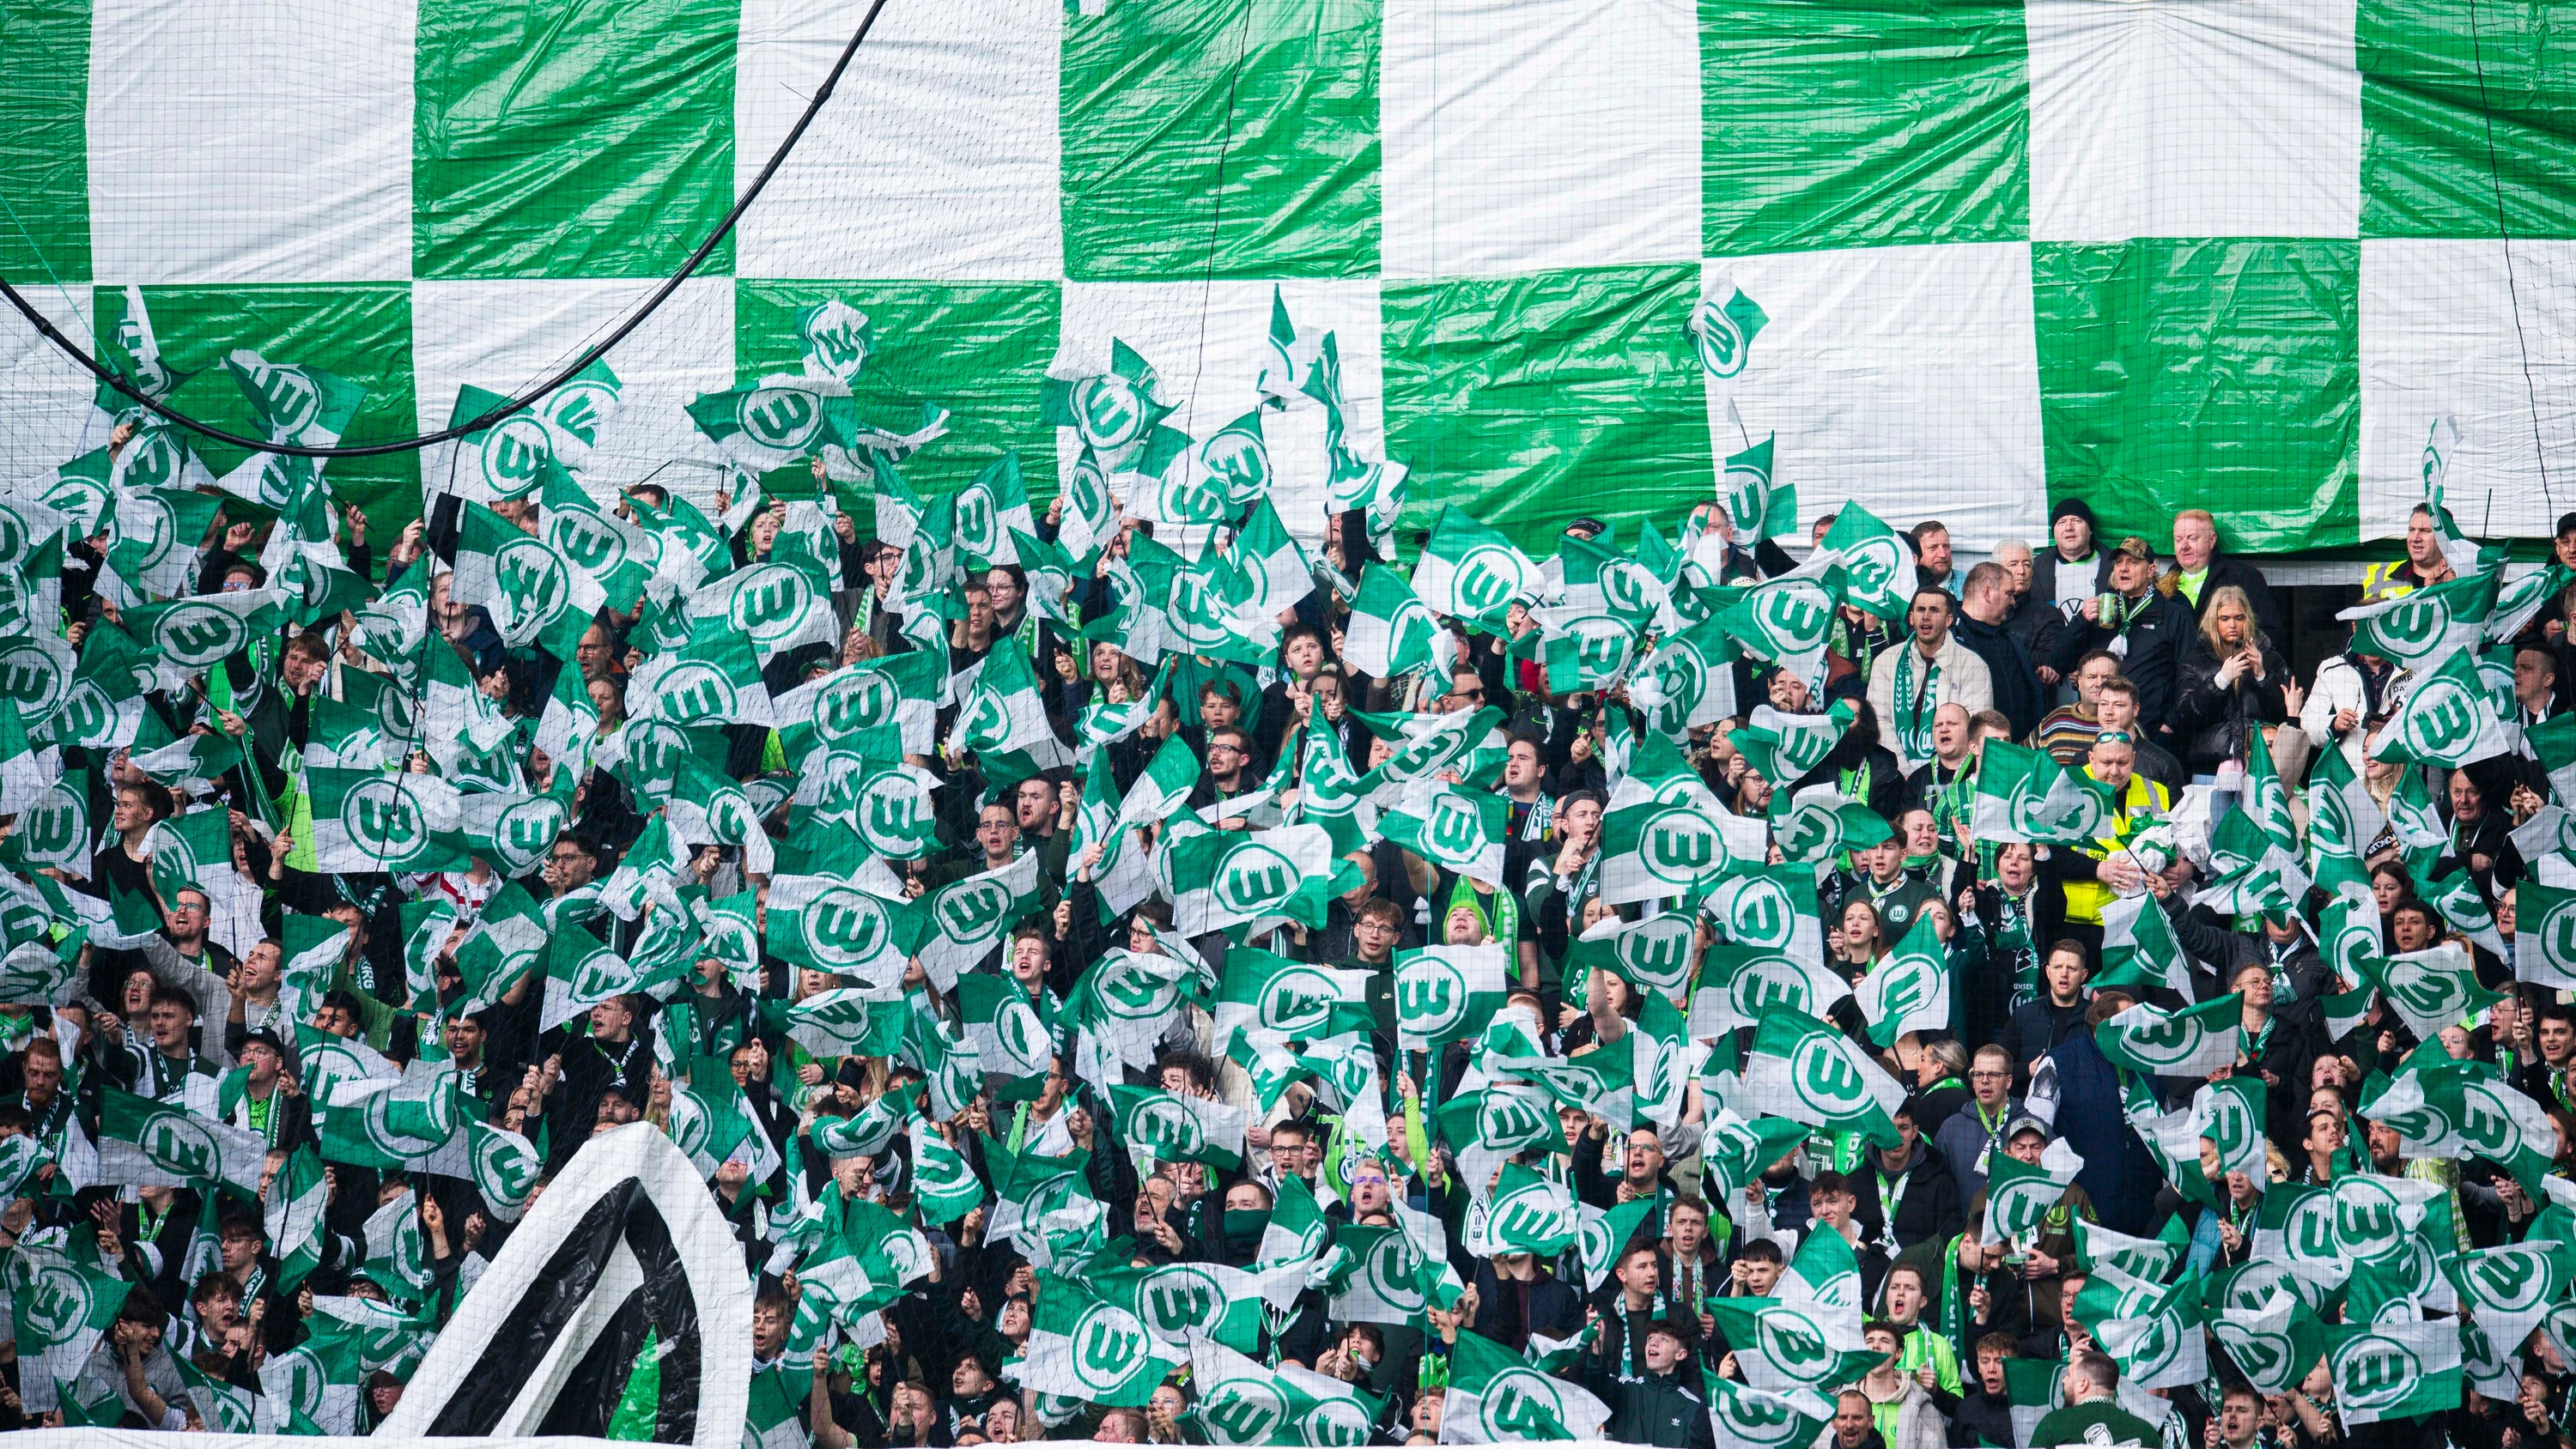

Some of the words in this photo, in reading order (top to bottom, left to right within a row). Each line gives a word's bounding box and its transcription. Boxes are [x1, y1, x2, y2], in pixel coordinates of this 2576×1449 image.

[814, 322, 859, 364] W
[749, 392, 811, 440] W
[496, 433, 548, 481] W
[559, 516, 615, 569] W
[744, 579, 797, 627] W
[1462, 561, 1515, 615] W
[166, 615, 232, 656] W
[1769, 591, 1826, 636] W
[662, 679, 724, 724] W
[828, 685, 883, 733] W
[2414, 694, 2471, 751] W
[510, 815, 562, 856] W
[872, 794, 919, 846] W
[1655, 828, 1712, 868] W
[1229, 866, 1287, 906] W
[815, 903, 878, 954] W
[944, 888, 1001, 934] W
[1632, 933, 1688, 976] W
[1396, 978, 1451, 1021] W
[1807, 1046, 1864, 1100] W
[157, 1125, 210, 1174] W
[2336, 1199, 2397, 1246] W
[1151, 1284, 1210, 1331] W
[1084, 1321, 1140, 1374] W
[2346, 1354, 2406, 1397] W
